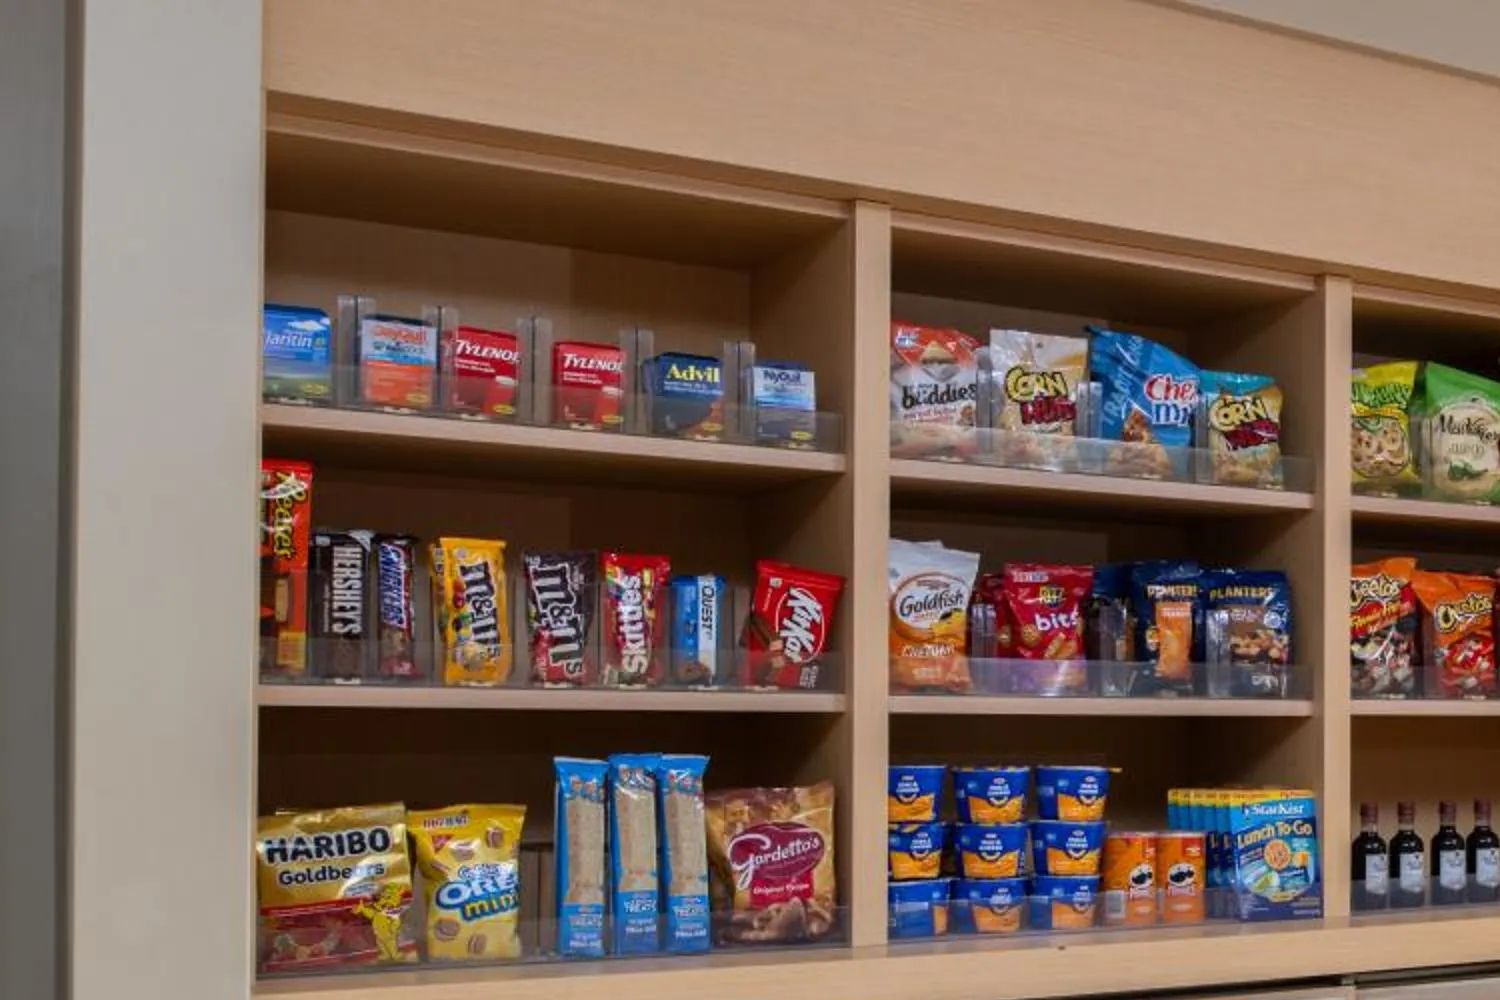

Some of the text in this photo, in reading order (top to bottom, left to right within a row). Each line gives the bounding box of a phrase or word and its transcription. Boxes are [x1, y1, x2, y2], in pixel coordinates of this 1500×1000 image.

[264, 331, 313, 349] laritin
[455, 338, 522, 364] TYLENOL
[563, 352, 625, 374] TYLENOL
[666, 363, 720, 384] Advil
[701, 586, 716, 635] QUEST
[900, 588, 964, 618] Goldfish
[1250, 799, 1305, 816] StarKist
[264, 827, 392, 865] HARIBO
[1236, 819, 1313, 849] Lunch To Go
[728, 832, 822, 891] Gardetto's
[435, 873, 519, 912] ORE
